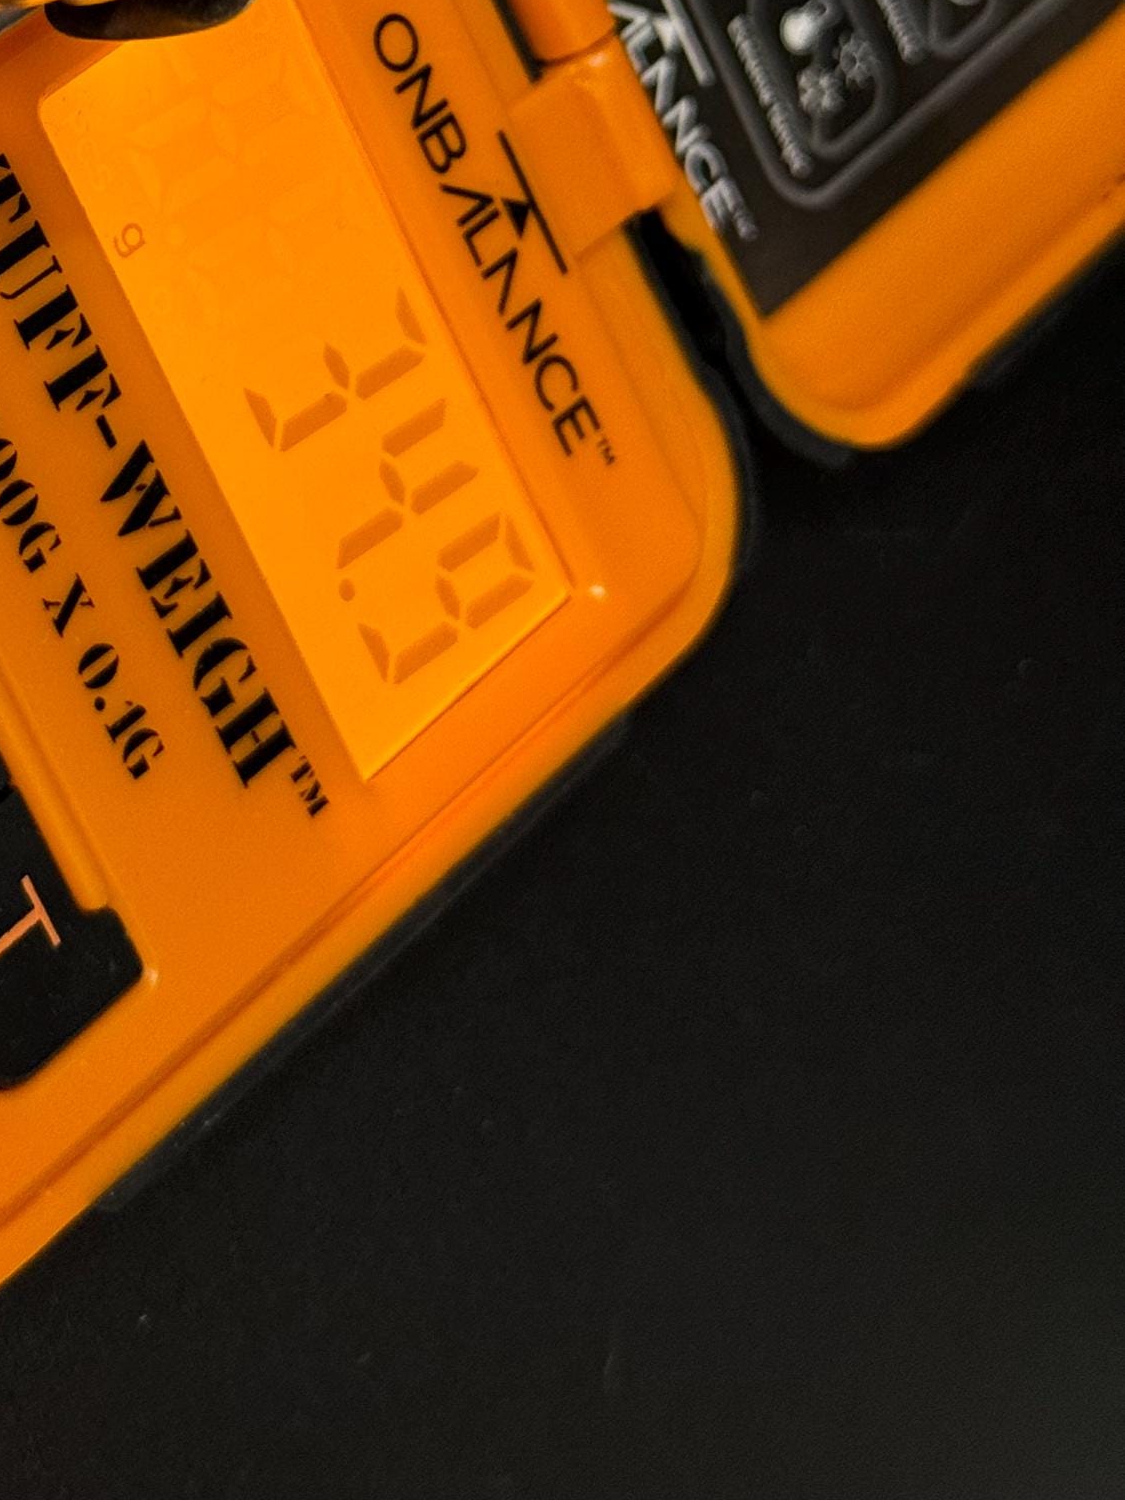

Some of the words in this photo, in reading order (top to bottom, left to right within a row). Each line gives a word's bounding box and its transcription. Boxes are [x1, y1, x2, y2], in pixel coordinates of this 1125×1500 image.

[243, 287, 536, 686] 34.9
[43, 574, 94, 637] X
[78, 644, 163, 779] 0.1G
